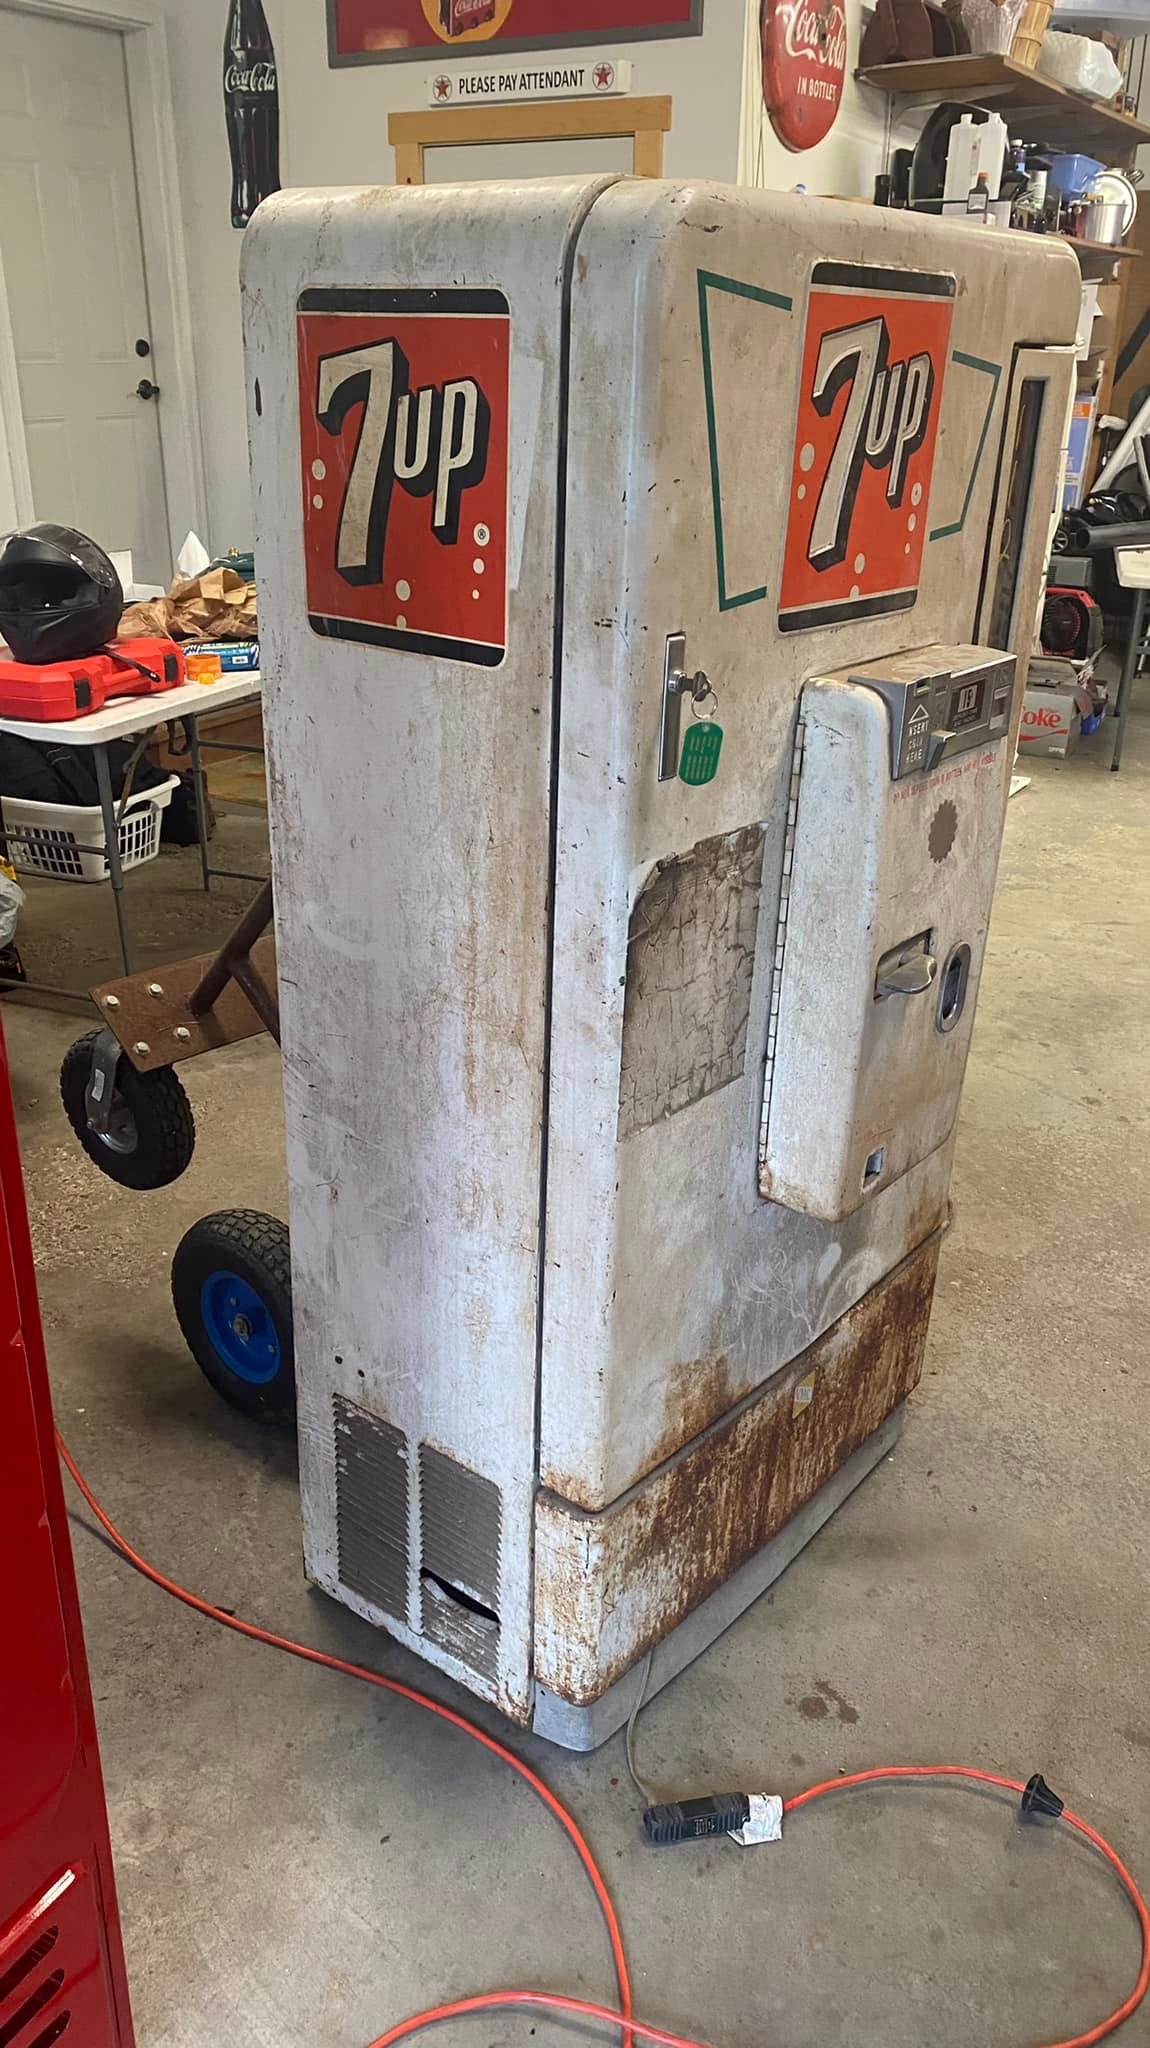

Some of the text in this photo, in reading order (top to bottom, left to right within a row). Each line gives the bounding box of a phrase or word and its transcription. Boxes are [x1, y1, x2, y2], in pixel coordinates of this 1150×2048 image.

[459, 69, 585, 95] PLEASE PAY ATTENDANT
[797, 76, 807, 96] IN
[1020, 704, 1062, 728] oke
